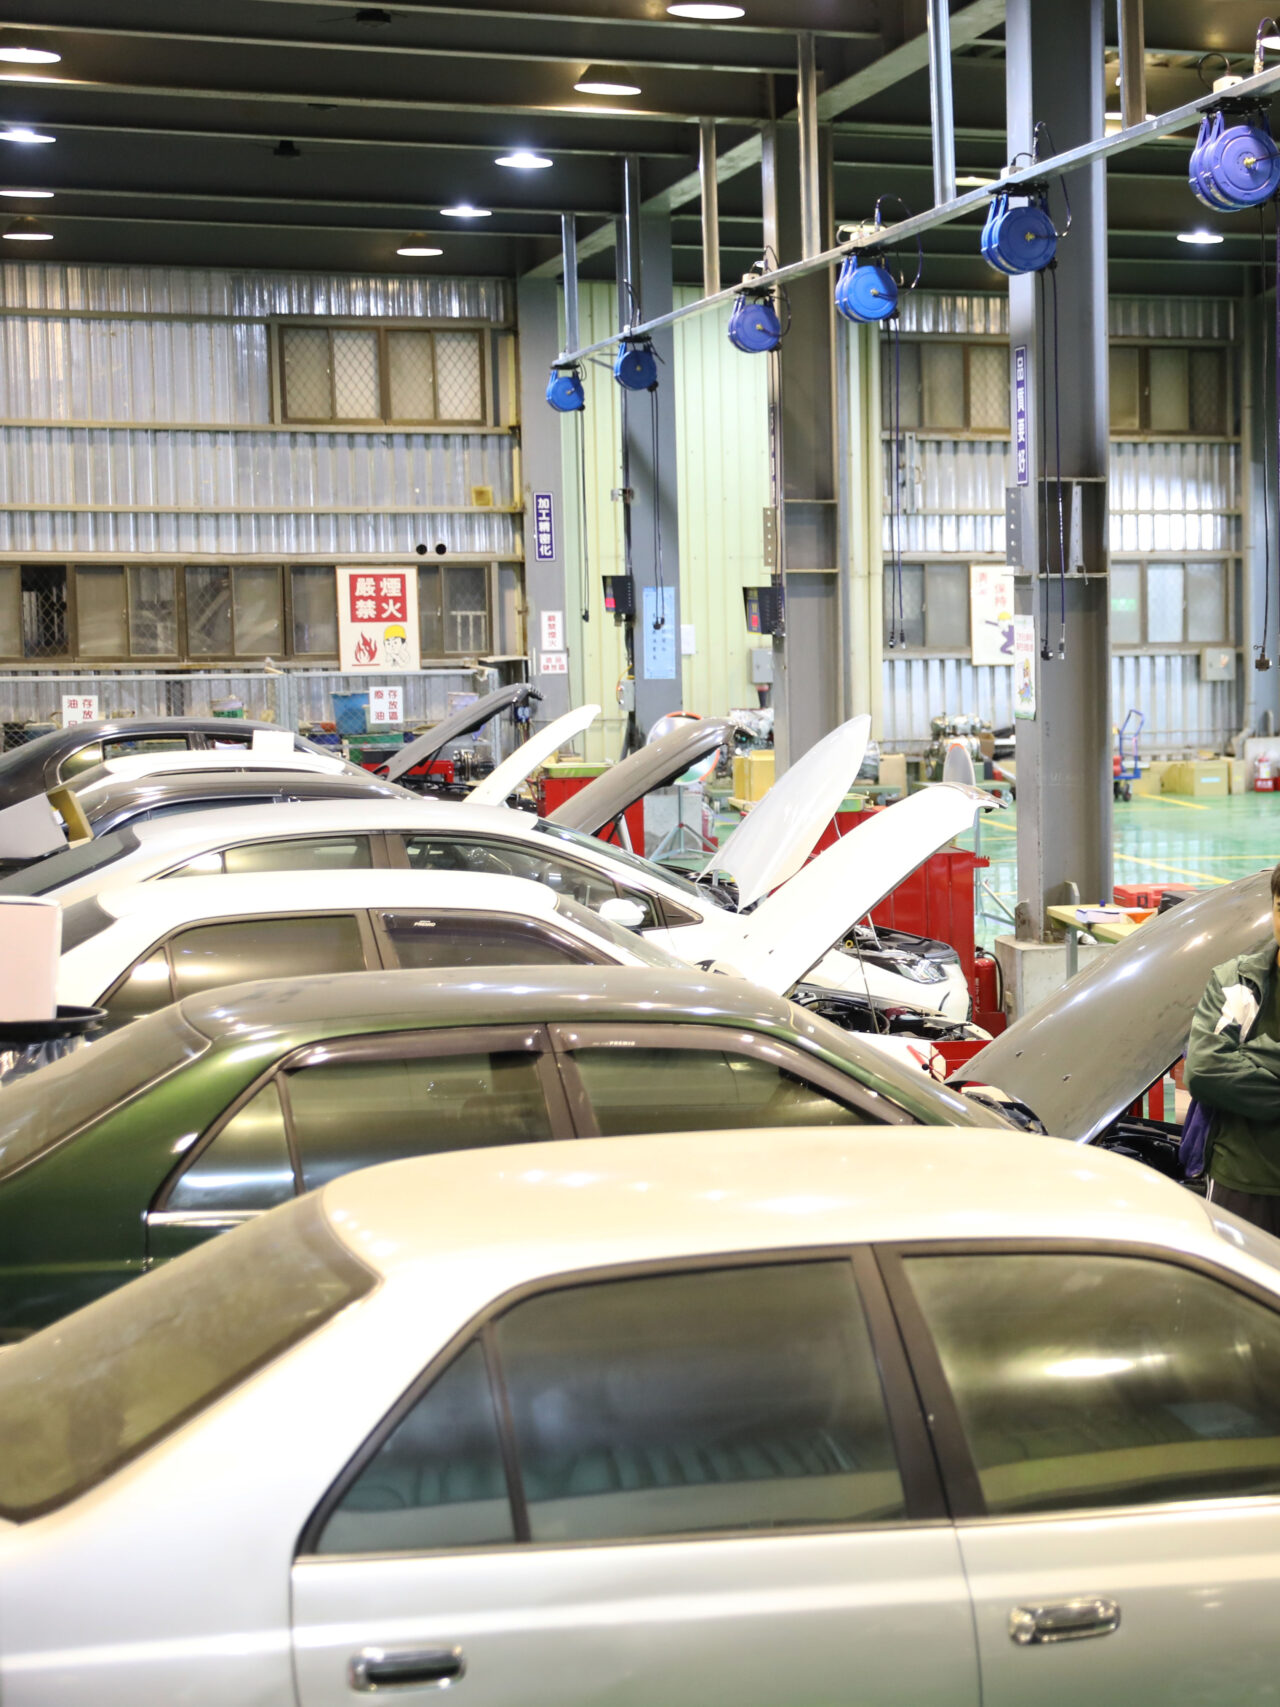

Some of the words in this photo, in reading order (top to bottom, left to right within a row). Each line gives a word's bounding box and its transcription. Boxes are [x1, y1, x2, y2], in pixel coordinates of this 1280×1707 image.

[537, 497, 552, 556] 加工精密化
